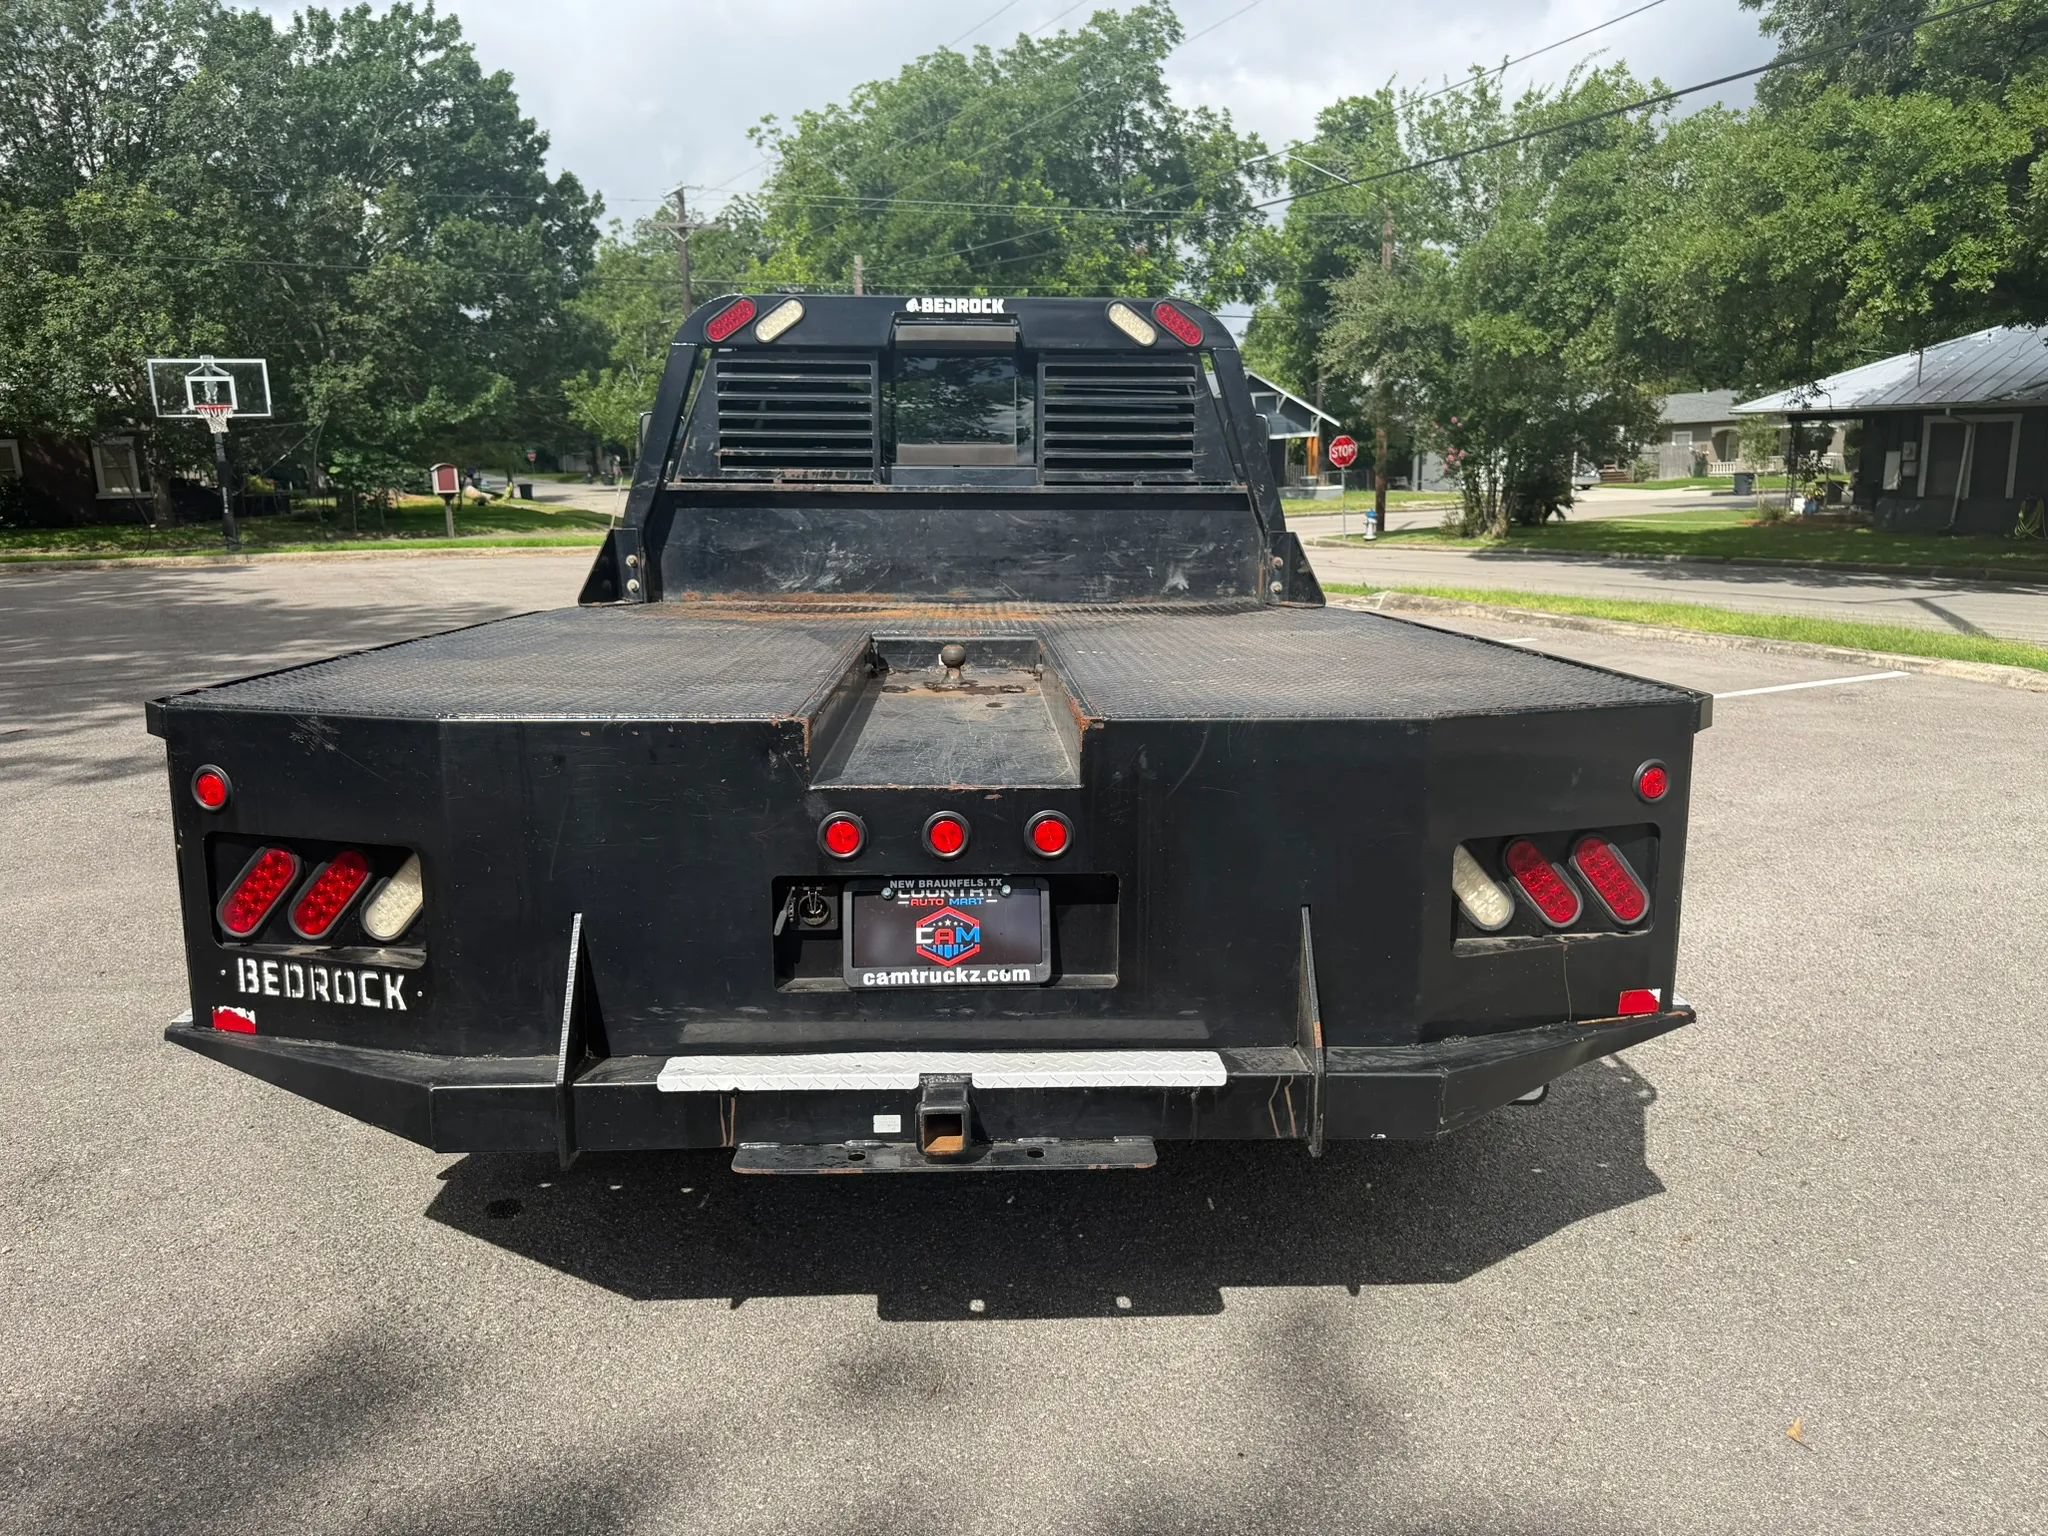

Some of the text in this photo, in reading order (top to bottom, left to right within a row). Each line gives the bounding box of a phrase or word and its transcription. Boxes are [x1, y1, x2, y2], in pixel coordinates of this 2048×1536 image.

[921, 297, 1005, 314] BEDROCK
[1331, 444, 1355, 459] STOP
[890, 880, 915, 889] NEW
[989, 878, 1003, 887] TX
[910, 897, 984, 907] AUTO MART
[915, 927, 981, 945] CAM
[237, 957, 407, 1011] BEDROCK
[862, 967, 1031, 986] camtruckz.com
